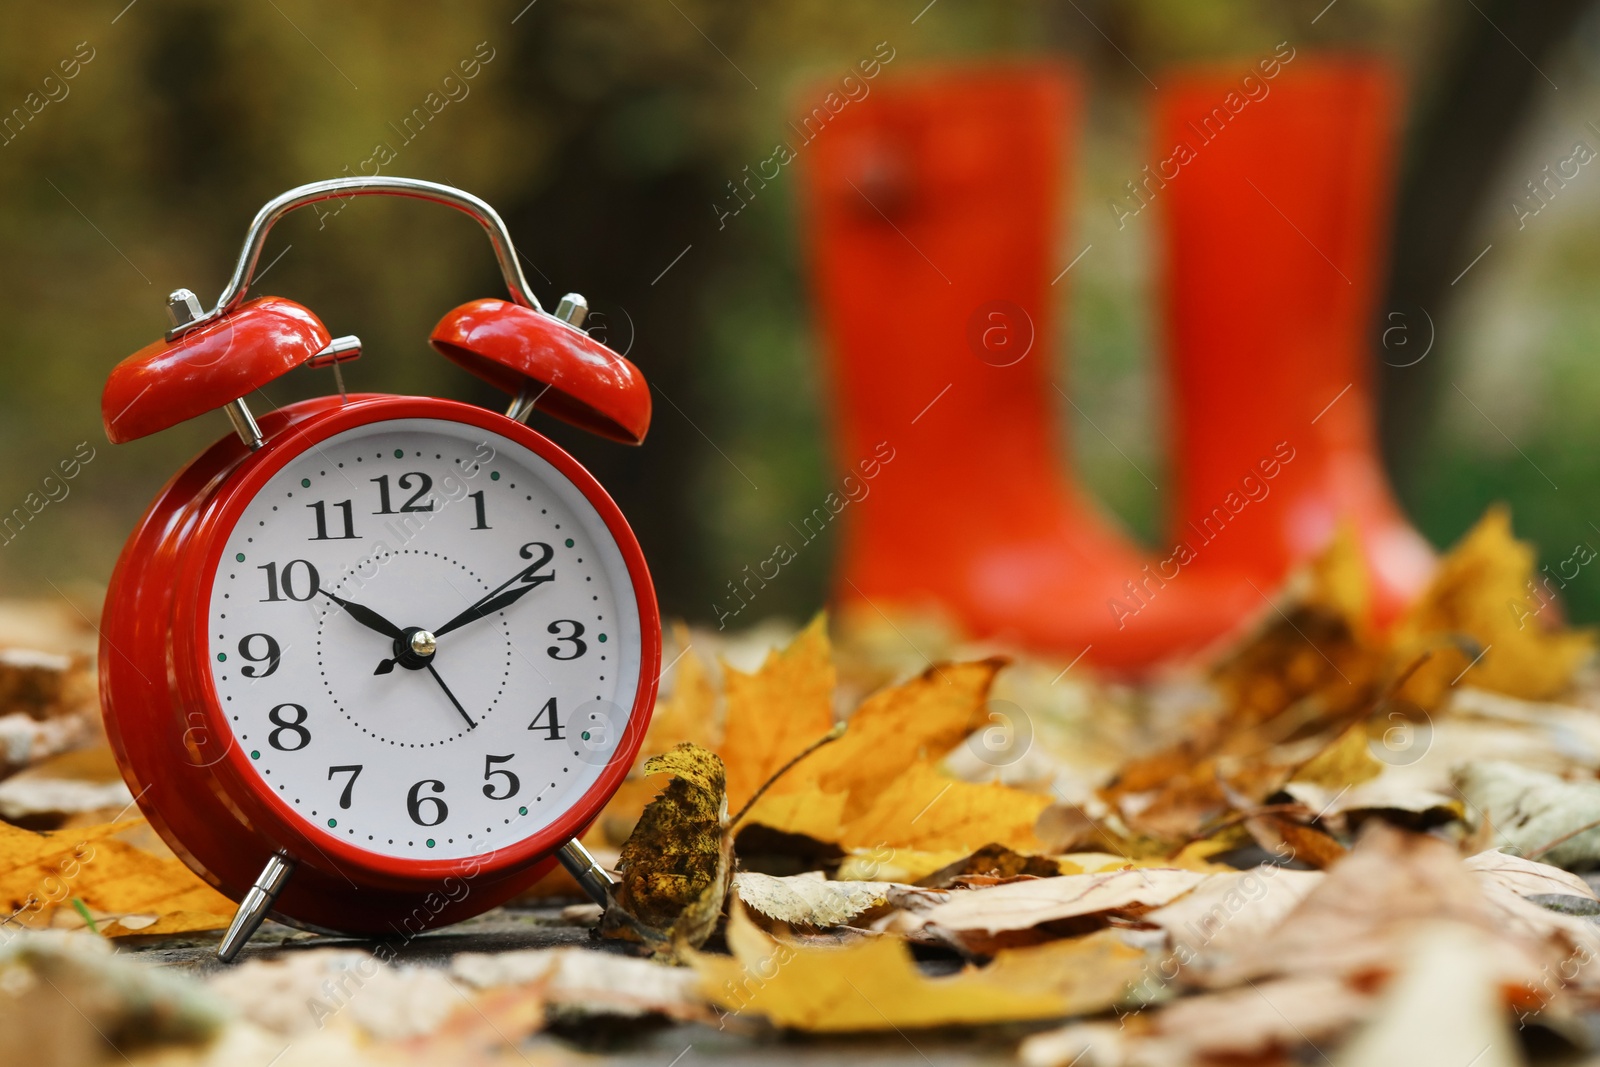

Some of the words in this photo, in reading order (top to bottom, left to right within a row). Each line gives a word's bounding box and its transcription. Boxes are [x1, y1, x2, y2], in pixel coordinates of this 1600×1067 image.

[370, 471, 434, 515] 12
[468, 490, 493, 531] 1
[306, 499, 363, 541] 11
[257, 559, 320, 603] 10
[519, 541, 556, 583] 2
[237, 633, 281, 679] 9
[546, 619, 588, 661] 3
[268, 703, 312, 751] 8
[527, 697, 566, 741] 4
[327, 764, 363, 810] 7
[482, 753, 520, 801] 5
[406, 779, 449, 827] 6
